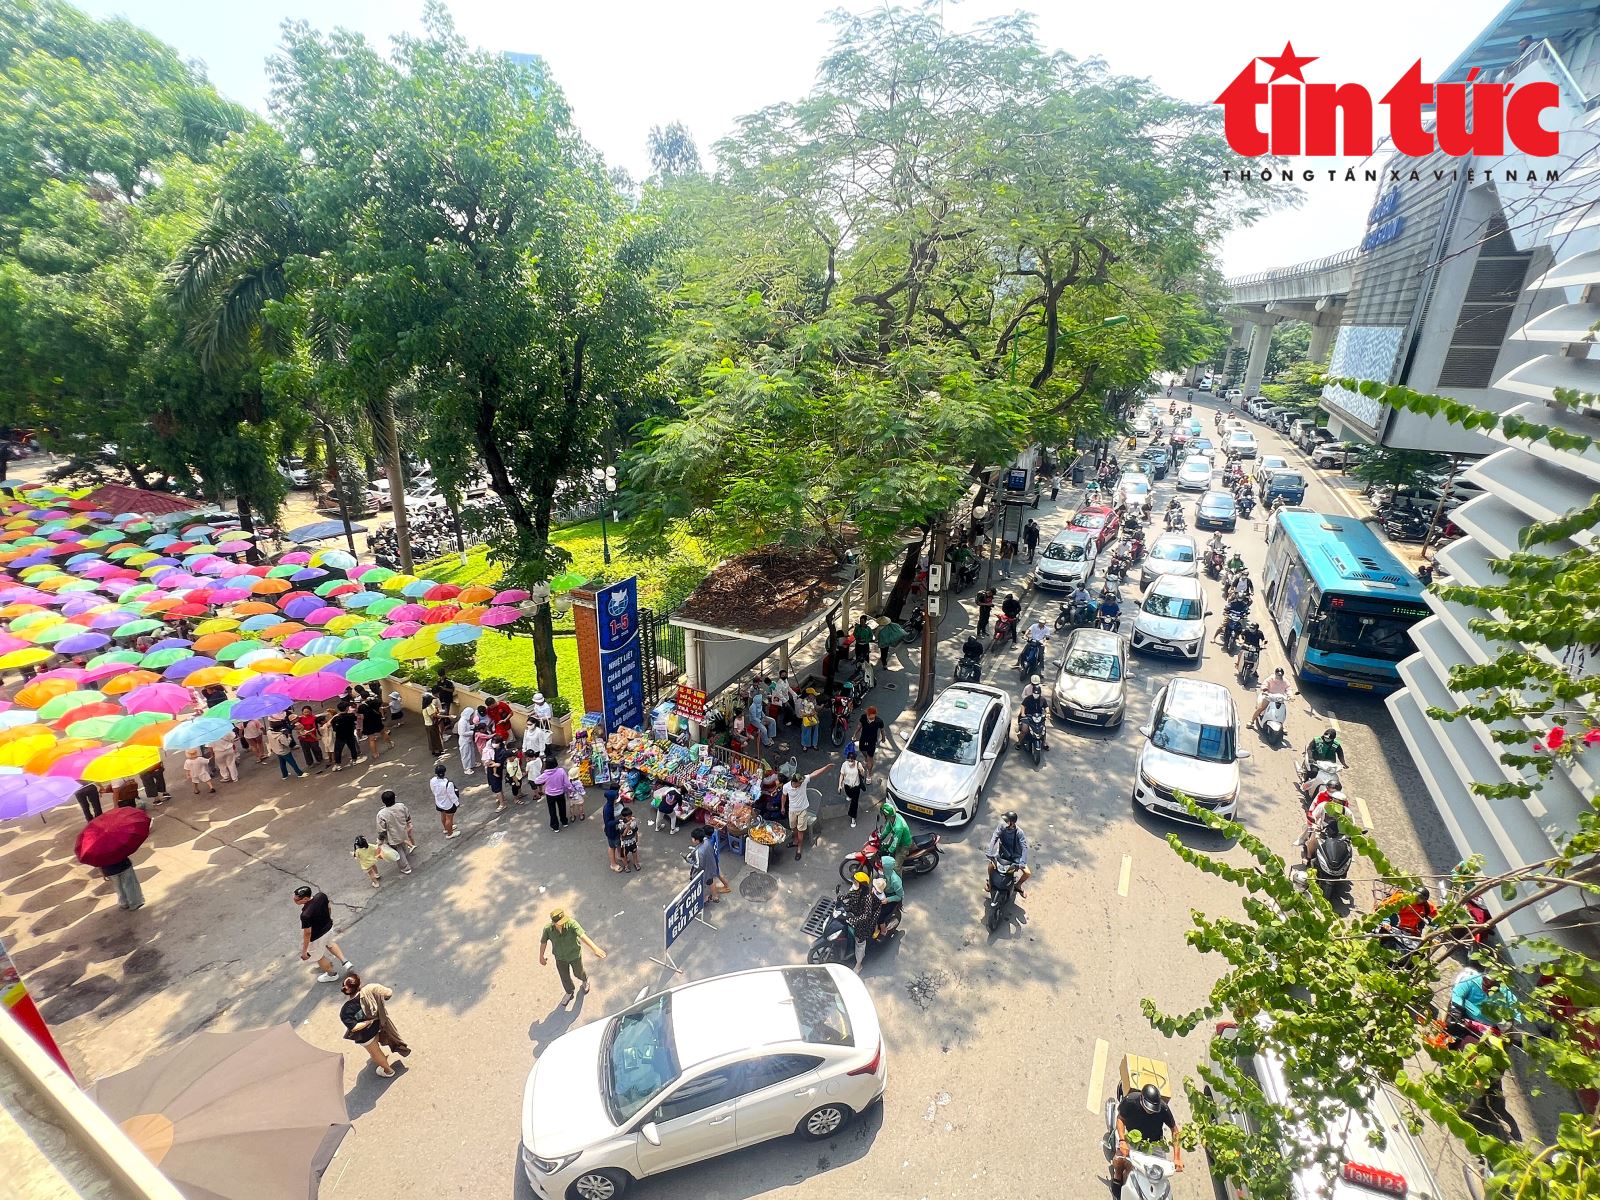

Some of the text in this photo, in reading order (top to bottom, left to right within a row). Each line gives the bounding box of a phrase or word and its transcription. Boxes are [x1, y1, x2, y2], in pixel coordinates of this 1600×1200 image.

[608, 650, 633, 670] NHIỆT LIỆT
[607, 661, 636, 683] CHÀO MỪNG
[621, 674, 633, 686] NĂM
[612, 717, 622, 728] LAO
[668, 903, 684, 928] HẾT
[685, 880, 702, 908] CHỖ
[688, 902, 699, 921] XE
[1348, 1167, 1403, 1192] Taxi 123
